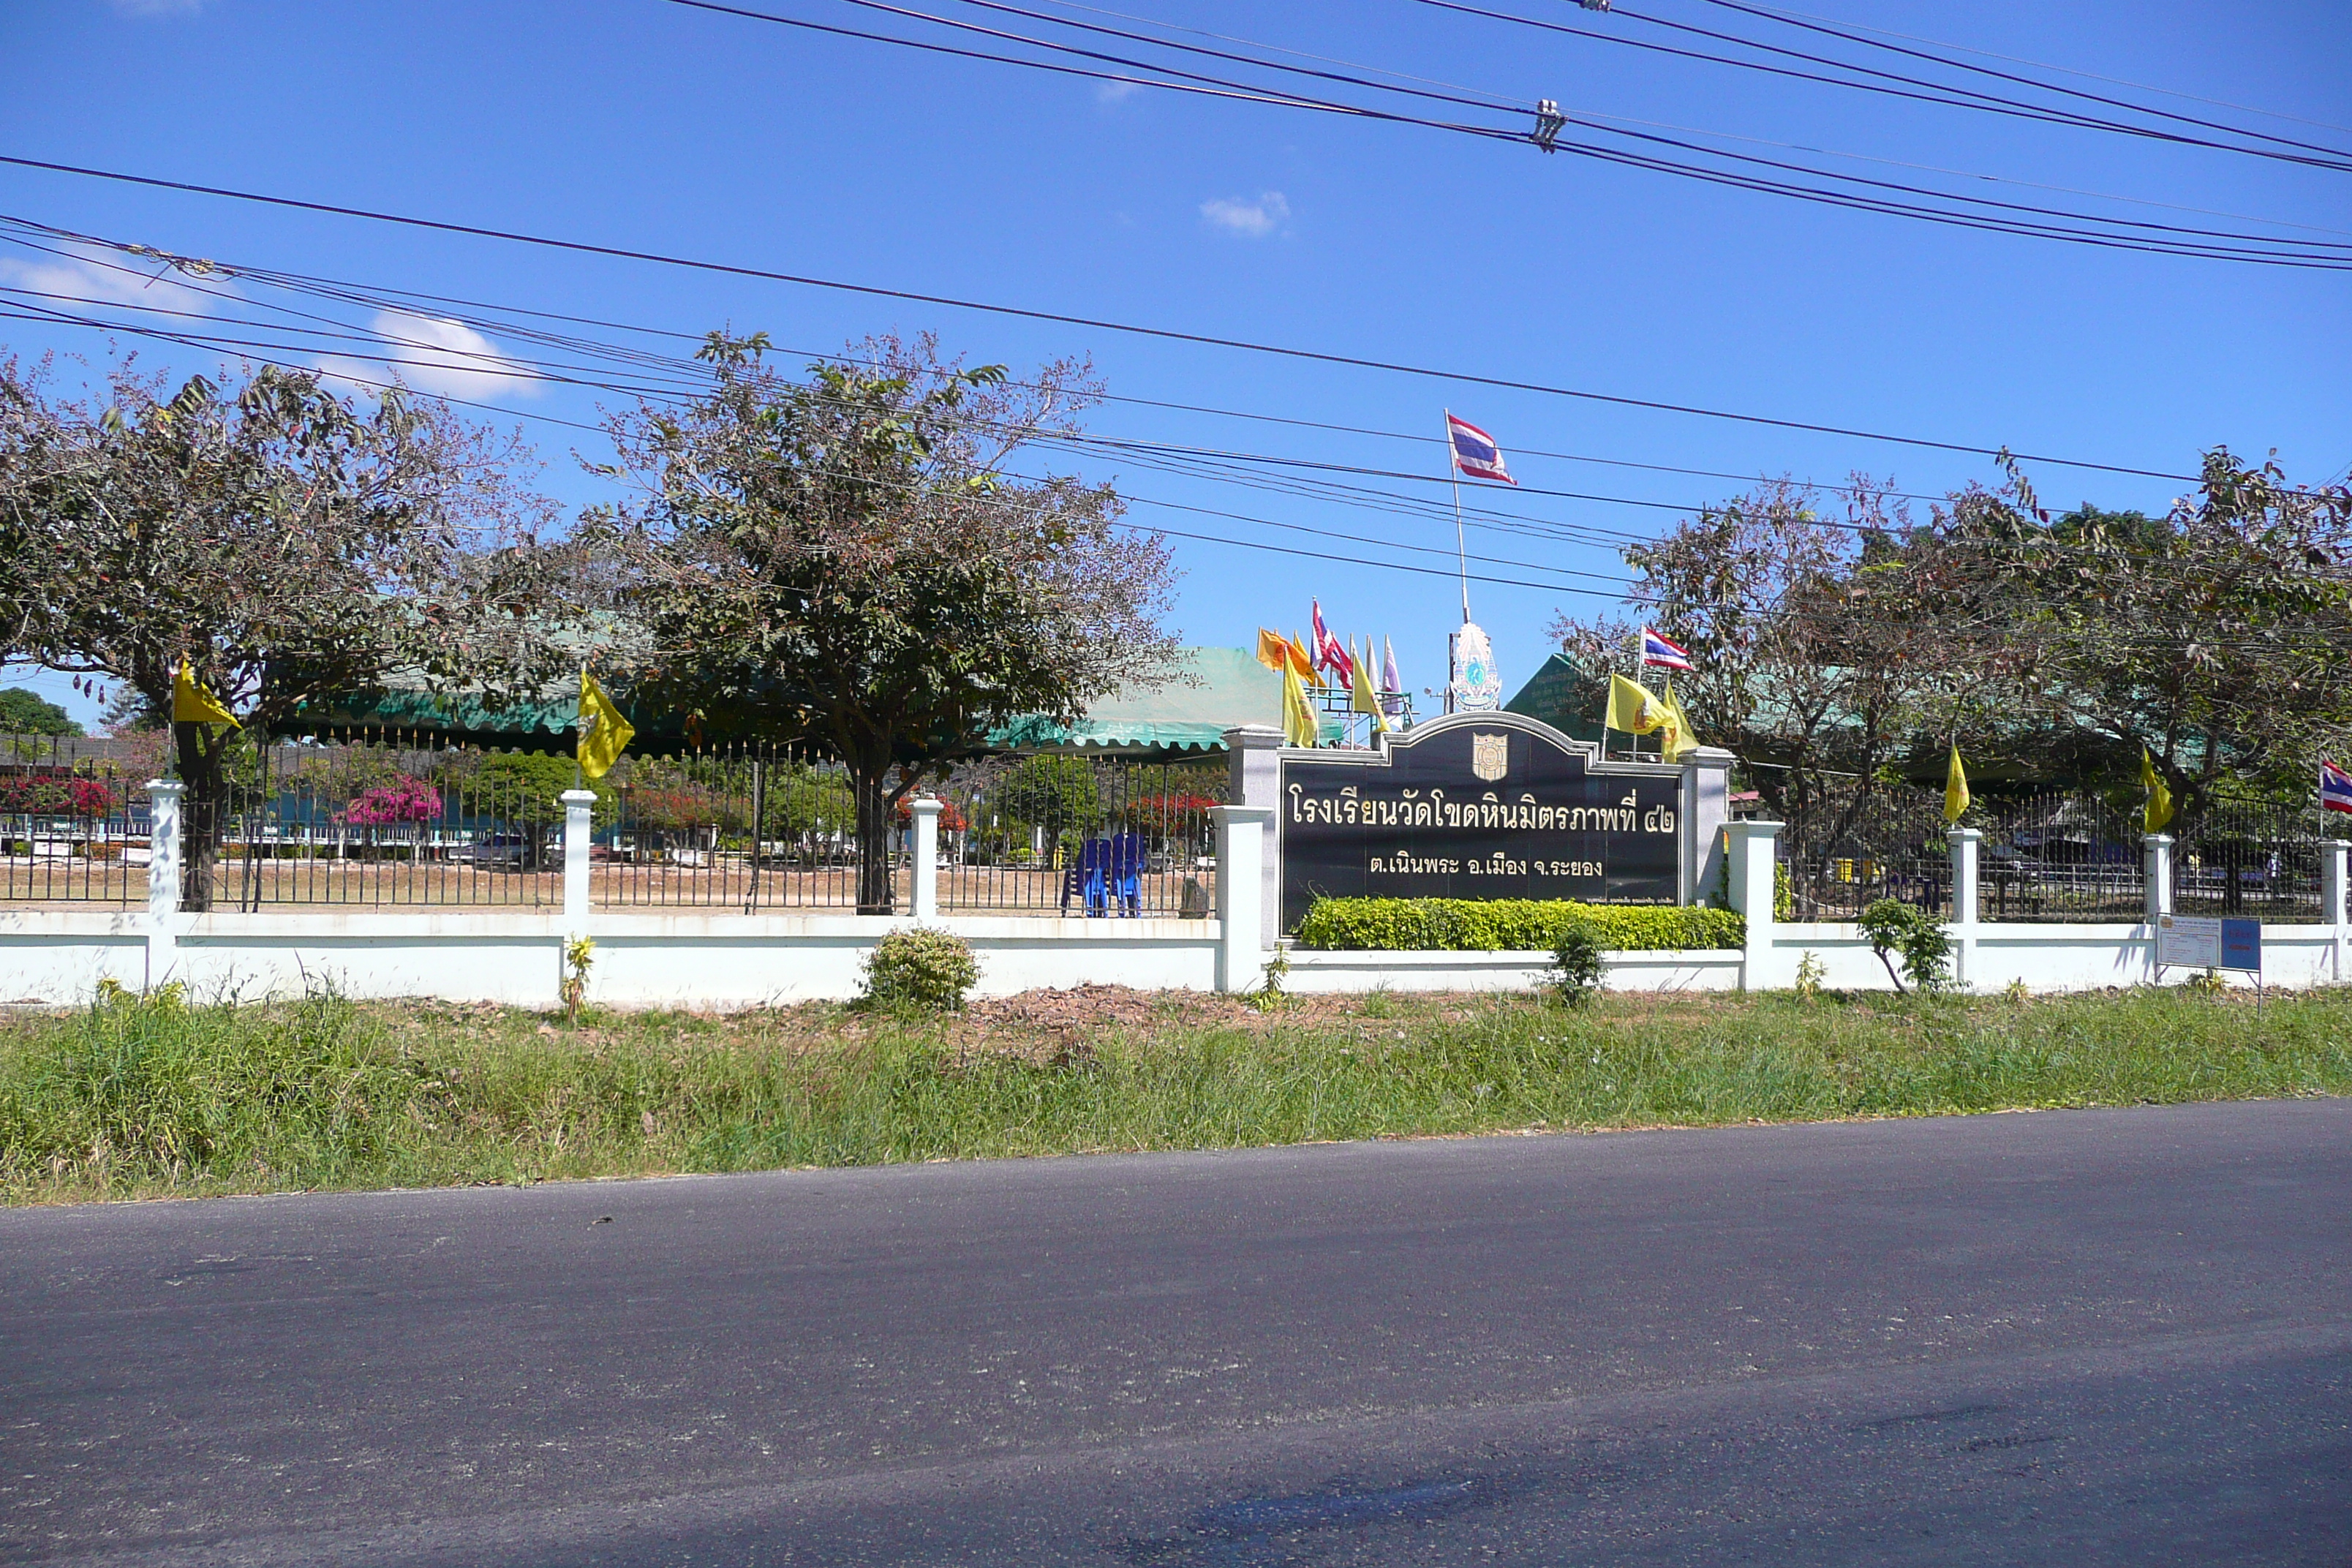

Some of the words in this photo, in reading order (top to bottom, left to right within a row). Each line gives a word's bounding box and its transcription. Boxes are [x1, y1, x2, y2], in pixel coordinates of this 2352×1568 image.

[1289, 783, 1636, 832] โรงเรียนวัดโขดหินมิตรภาพที่
[1644, 804, 1675, 833] ๔๒
[1371, 850, 1459, 873] ต.เนินพระ
[1468, 852, 1527, 875] อ.เมือง
[1534, 861, 1602, 876] จ.ระยอง
